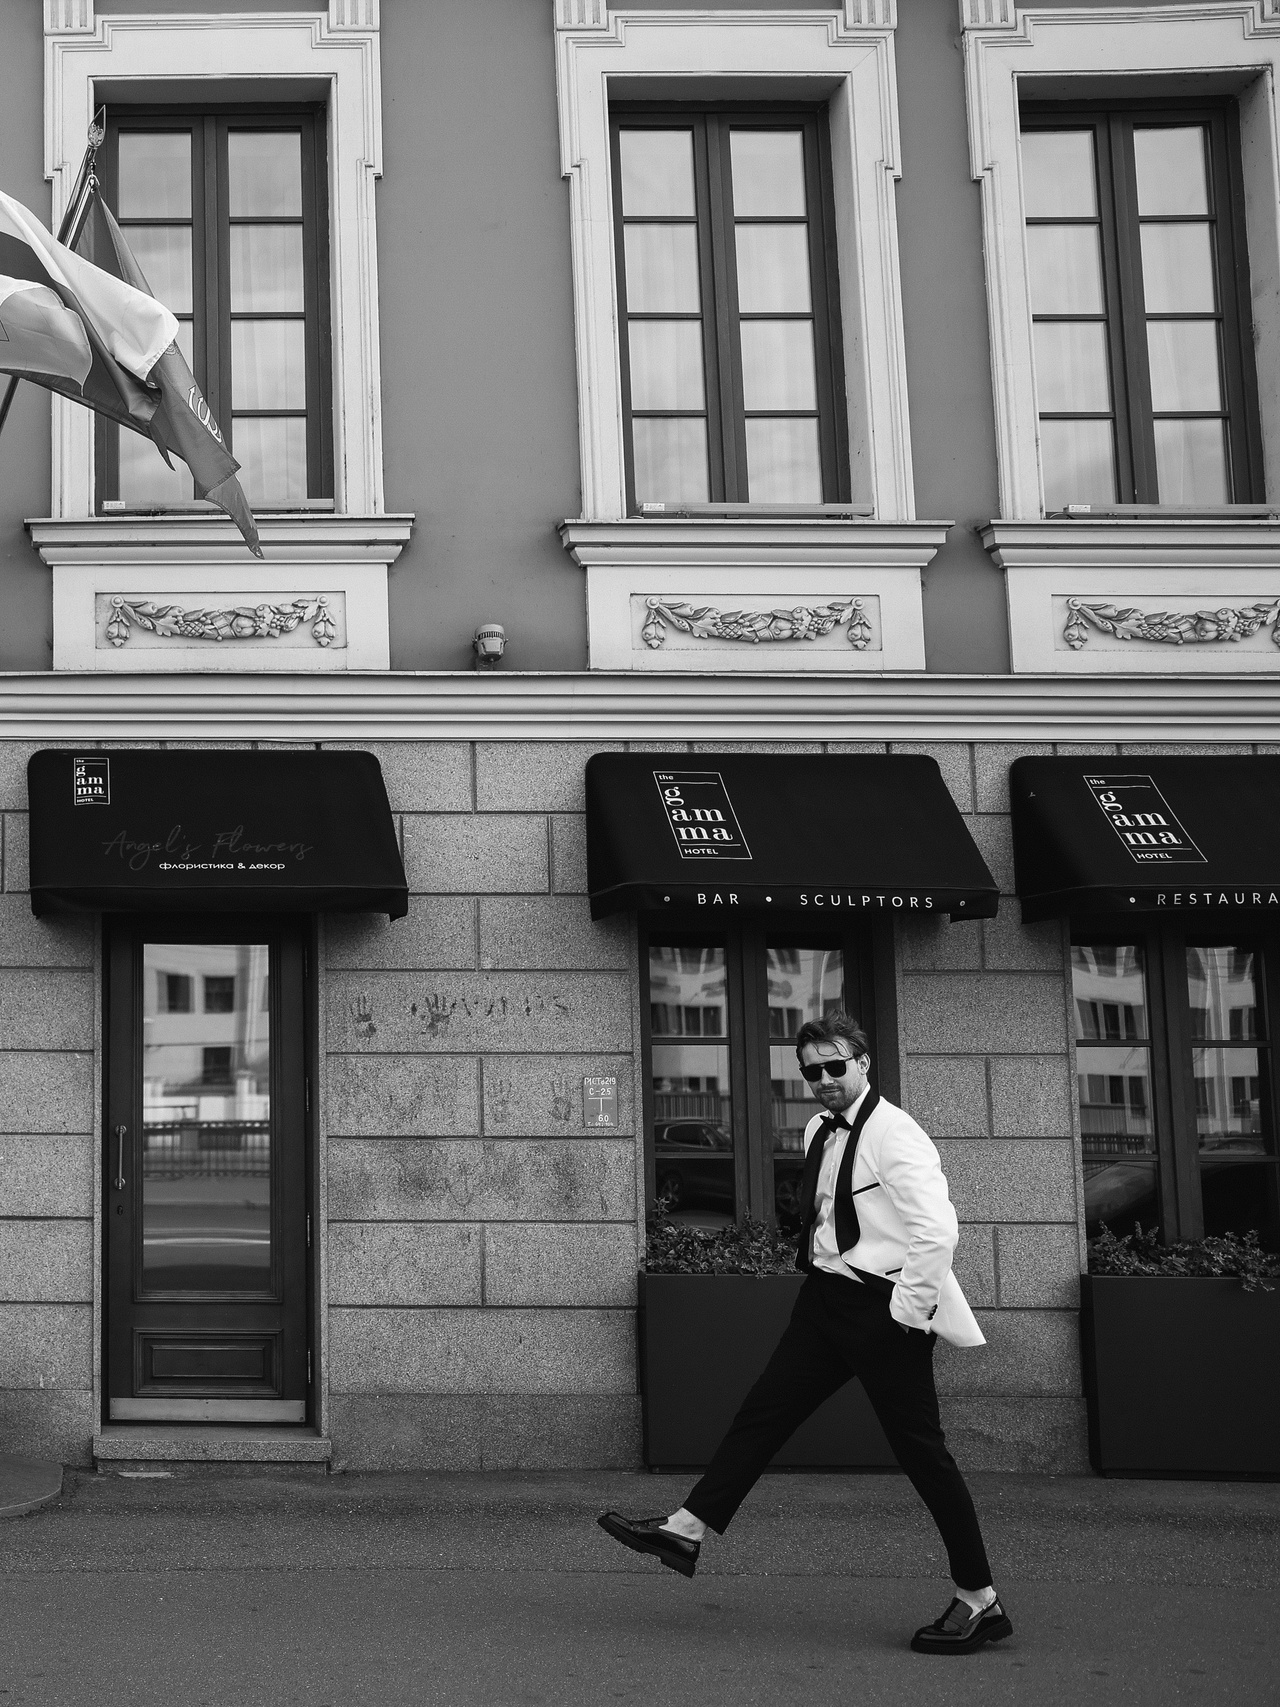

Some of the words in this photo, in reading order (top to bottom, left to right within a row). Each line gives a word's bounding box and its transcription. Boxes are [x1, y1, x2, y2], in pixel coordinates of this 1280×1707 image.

[102, 824, 202, 870] Angel's
[211, 824, 314, 860] Flowers
[684, 848, 719, 856] HOTEL
[1136, 852, 1173, 860] HOTEL
[158, 862, 234, 871] флористика
[237, 862, 246, 870] &
[248, 863, 286, 871] декор
[697, 893, 739, 905] BAR
[800, 894, 933, 909] SCULPTORS
[1157, 892, 1279, 905] RESTAURA
